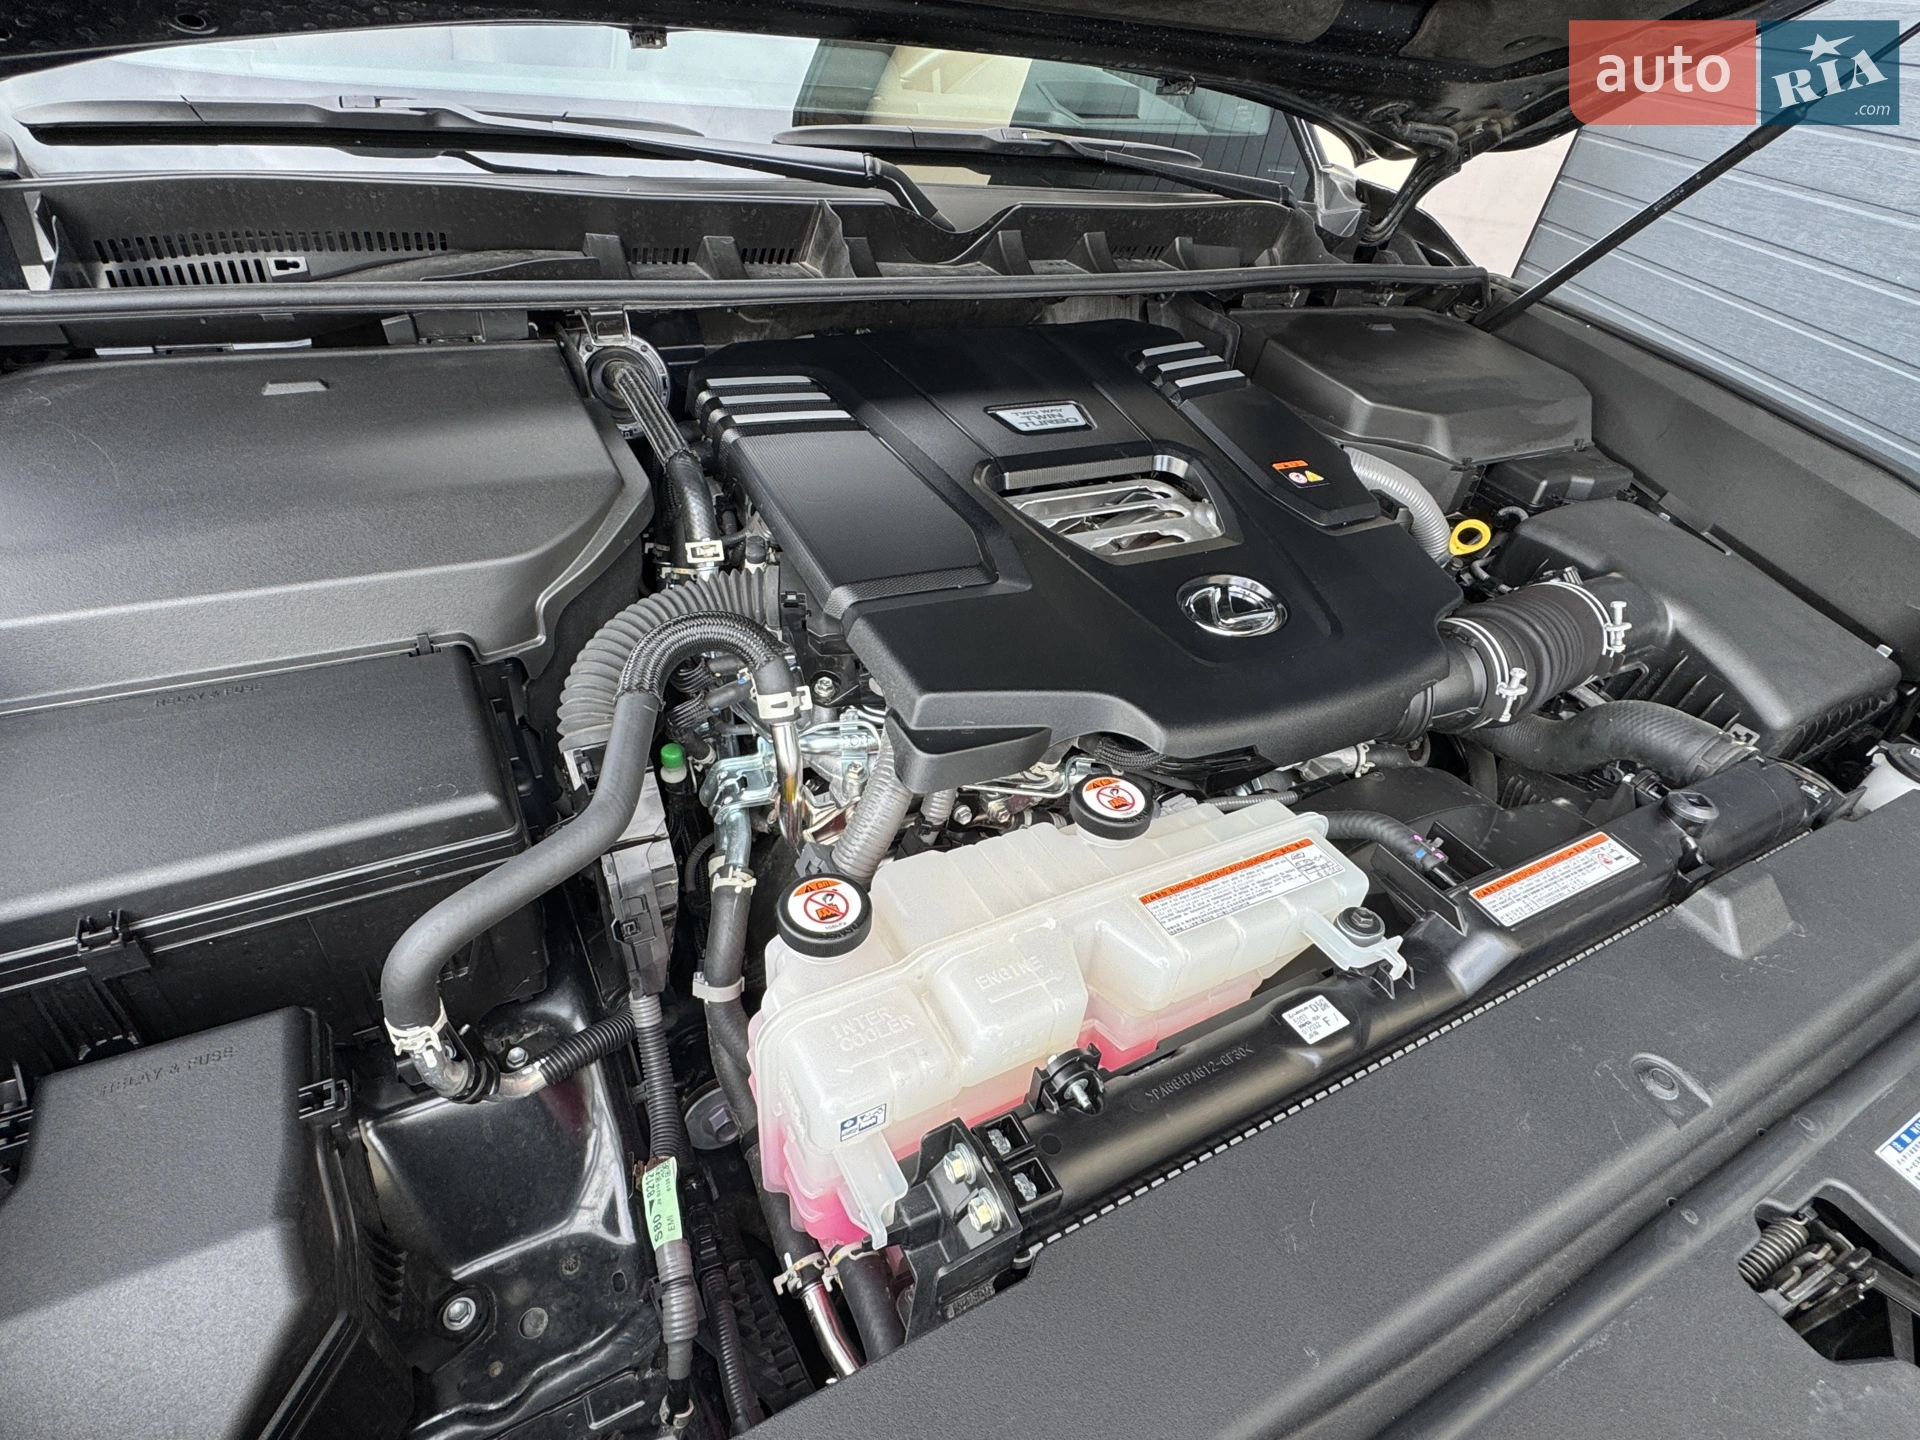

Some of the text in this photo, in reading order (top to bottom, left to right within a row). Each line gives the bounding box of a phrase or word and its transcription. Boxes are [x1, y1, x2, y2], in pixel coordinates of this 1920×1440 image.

[1011, 408, 1063, 417] TWO WAY
[1018, 417, 1079, 428] TURBO
[1020, 412, 1064, 421] TWIN
[154, 691, 205, 707] RELAY
[223, 682, 263, 696] FUSE
[976, 955, 1043, 990] ENGINE
[832, 1007, 893, 1038] INTER
[839, 1014, 916, 1051] COOLER
[1322, 1016, 1331, 1026] F
[102, 1066, 163, 1096] RELAY
[188, 1046, 234, 1070] FUSE
[653, 1213, 664, 1242] S80
